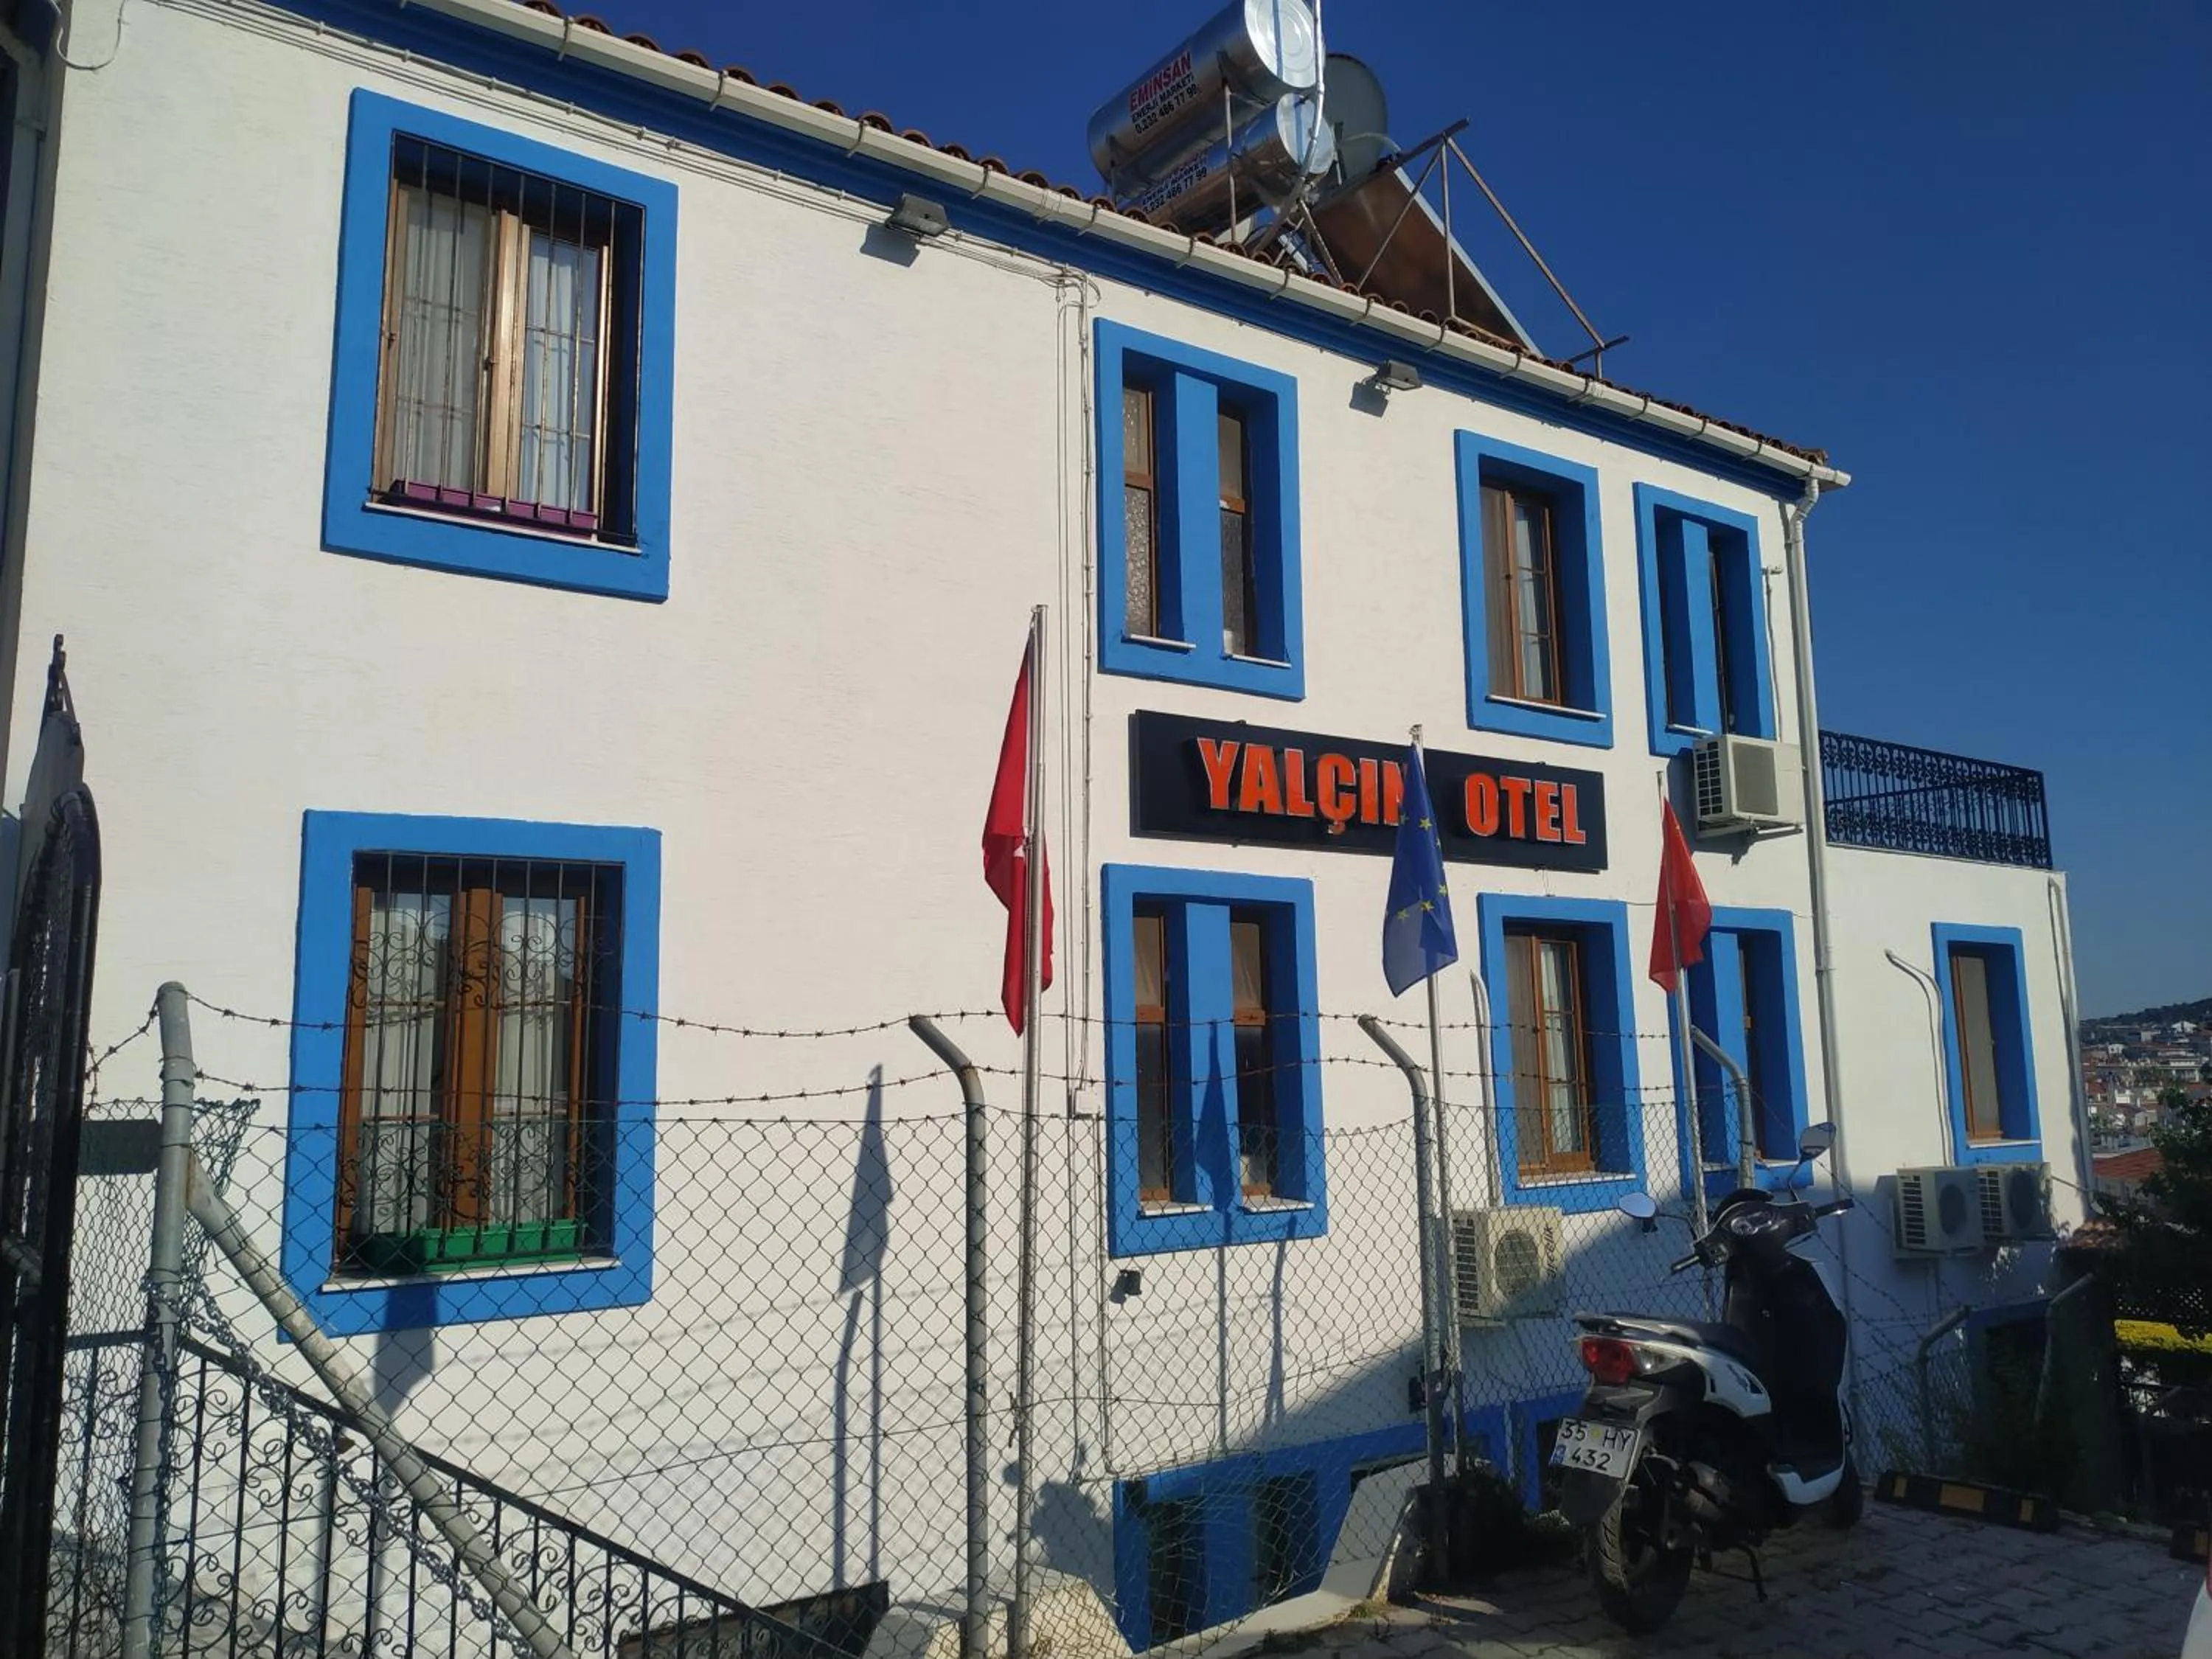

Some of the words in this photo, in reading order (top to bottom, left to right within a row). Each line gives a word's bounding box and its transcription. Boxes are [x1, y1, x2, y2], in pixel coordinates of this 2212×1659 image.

[1464, 772, 1587, 844] OTEL
[1562, 1419, 1587, 1442] 35
[1602, 1427, 1634, 1453] HY
[1571, 1446, 1612, 1472] 432
